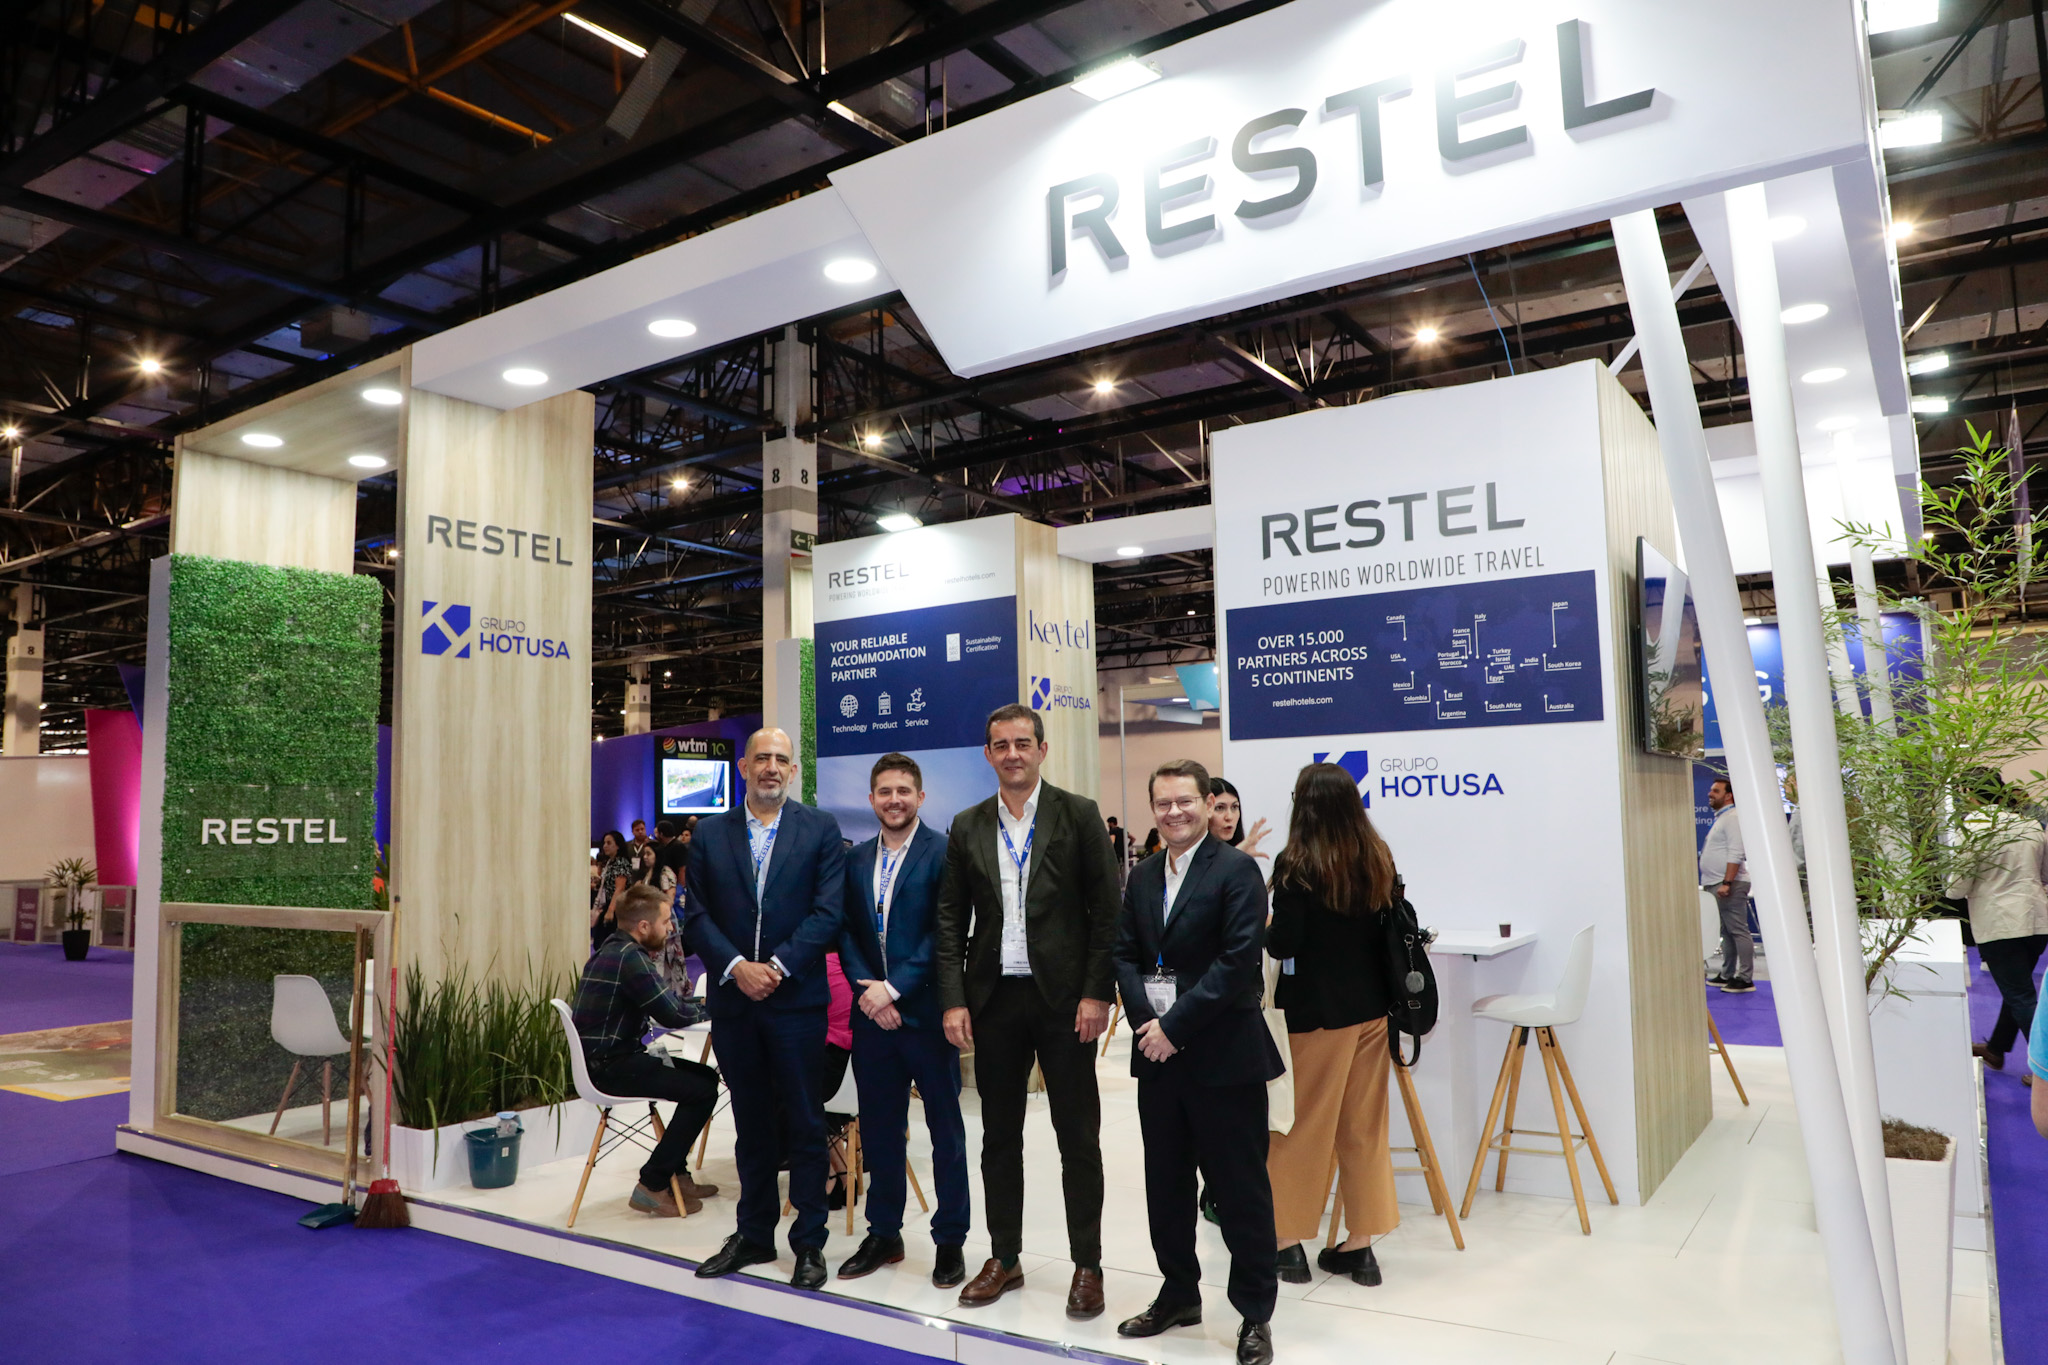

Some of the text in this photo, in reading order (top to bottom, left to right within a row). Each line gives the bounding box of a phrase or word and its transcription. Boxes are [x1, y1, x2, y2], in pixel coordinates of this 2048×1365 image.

[1050, 18, 1656, 277] RESTEL
[772, 468, 780, 485] 8
[801, 469, 809, 485] 8
[1261, 481, 1526, 561] RESTEL
[427, 514, 573, 567] RESTEL
[828, 562, 910, 589] RESTEL
[944, 571, 996, 585] restelhotels.com
[1263, 546, 1545, 597] POWERING WORLDWIDE TRAVEL
[828, 590, 857, 602] POWERING
[479, 616, 526, 634] GRUPO
[479, 632, 571, 661] HOTUSA
[830, 633, 908, 653] YOUR RELIABLE
[965, 636, 1002, 646] Sustainability
[1257, 629, 1345, 650] OVER 15.000
[965, 644, 999, 653] Certification
[830, 646, 927, 668] ACCOMMODATION
[1237, 646, 1368, 670] PARTNERS ACROSS
[831, 667, 877, 682] PARTNER
[1251, 666, 1354, 688] 5 CONTINENTS
[1054, 684, 1072, 694] GRUPO
[1054, 694, 1091, 710] HOTUSA
[1272, 697, 1333, 707] restelhotels.com
[1549, 702, 1574, 710] Australia
[905, 717, 929, 727] Service
[1441, 710, 1466, 718] Argentina
[832, 722, 867, 734] Technology
[872, 720, 898, 730] Product
[677, 737, 708, 753] wtm
[711, 742, 726, 756] 10
[1380, 756, 1438, 773] GRUPO
[1380, 772, 1505, 798] HOTUSA
[201, 817, 348, 845] RESTEL
